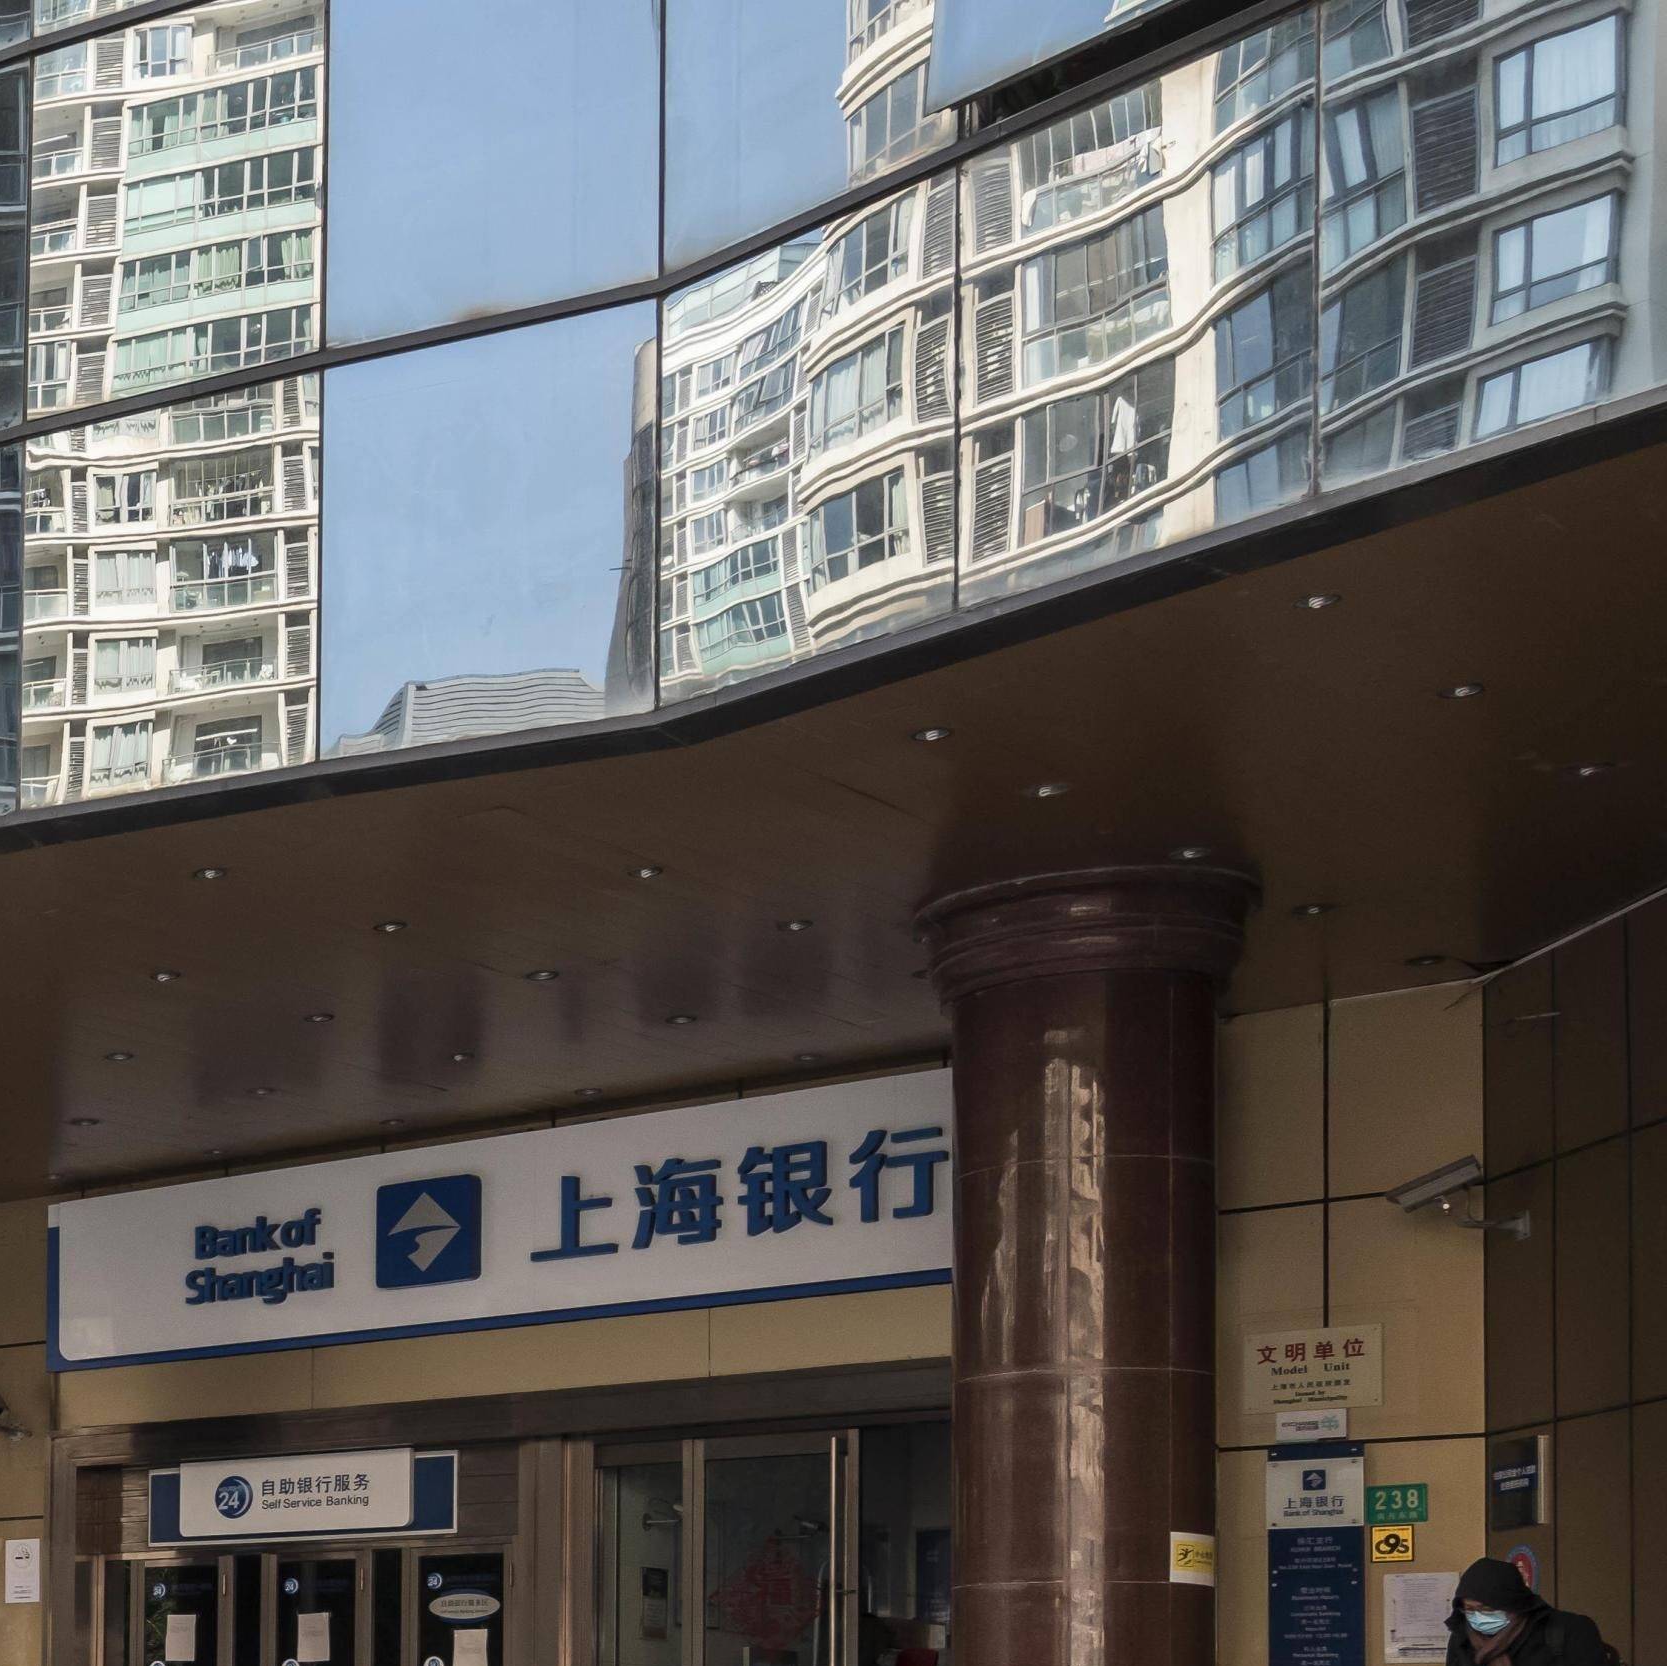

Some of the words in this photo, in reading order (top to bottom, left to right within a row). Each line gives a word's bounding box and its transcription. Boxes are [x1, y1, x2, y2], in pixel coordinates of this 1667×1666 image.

[529, 1126, 951, 1263] 上海银行
[193, 1216, 281, 1260] Bank
[280, 1206, 321, 1248] of
[184, 1250, 336, 1306] Shanghai
[1256, 1338, 1366, 1366] 文明单位
[1270, 1365, 1308, 1377] Model
[1323, 1361, 1351, 1372] Unit
[260, 1473, 371, 1497] 自助银行服务
[217, 1491, 240, 1511] 24
[261, 1498, 282, 1511] Self
[283, 1495, 323, 1509] Service
[325, 1494, 370, 1508] Banking
[1283, 1495, 1345, 1510] 上海银行
[1374, 1489, 1419, 1511] 238
